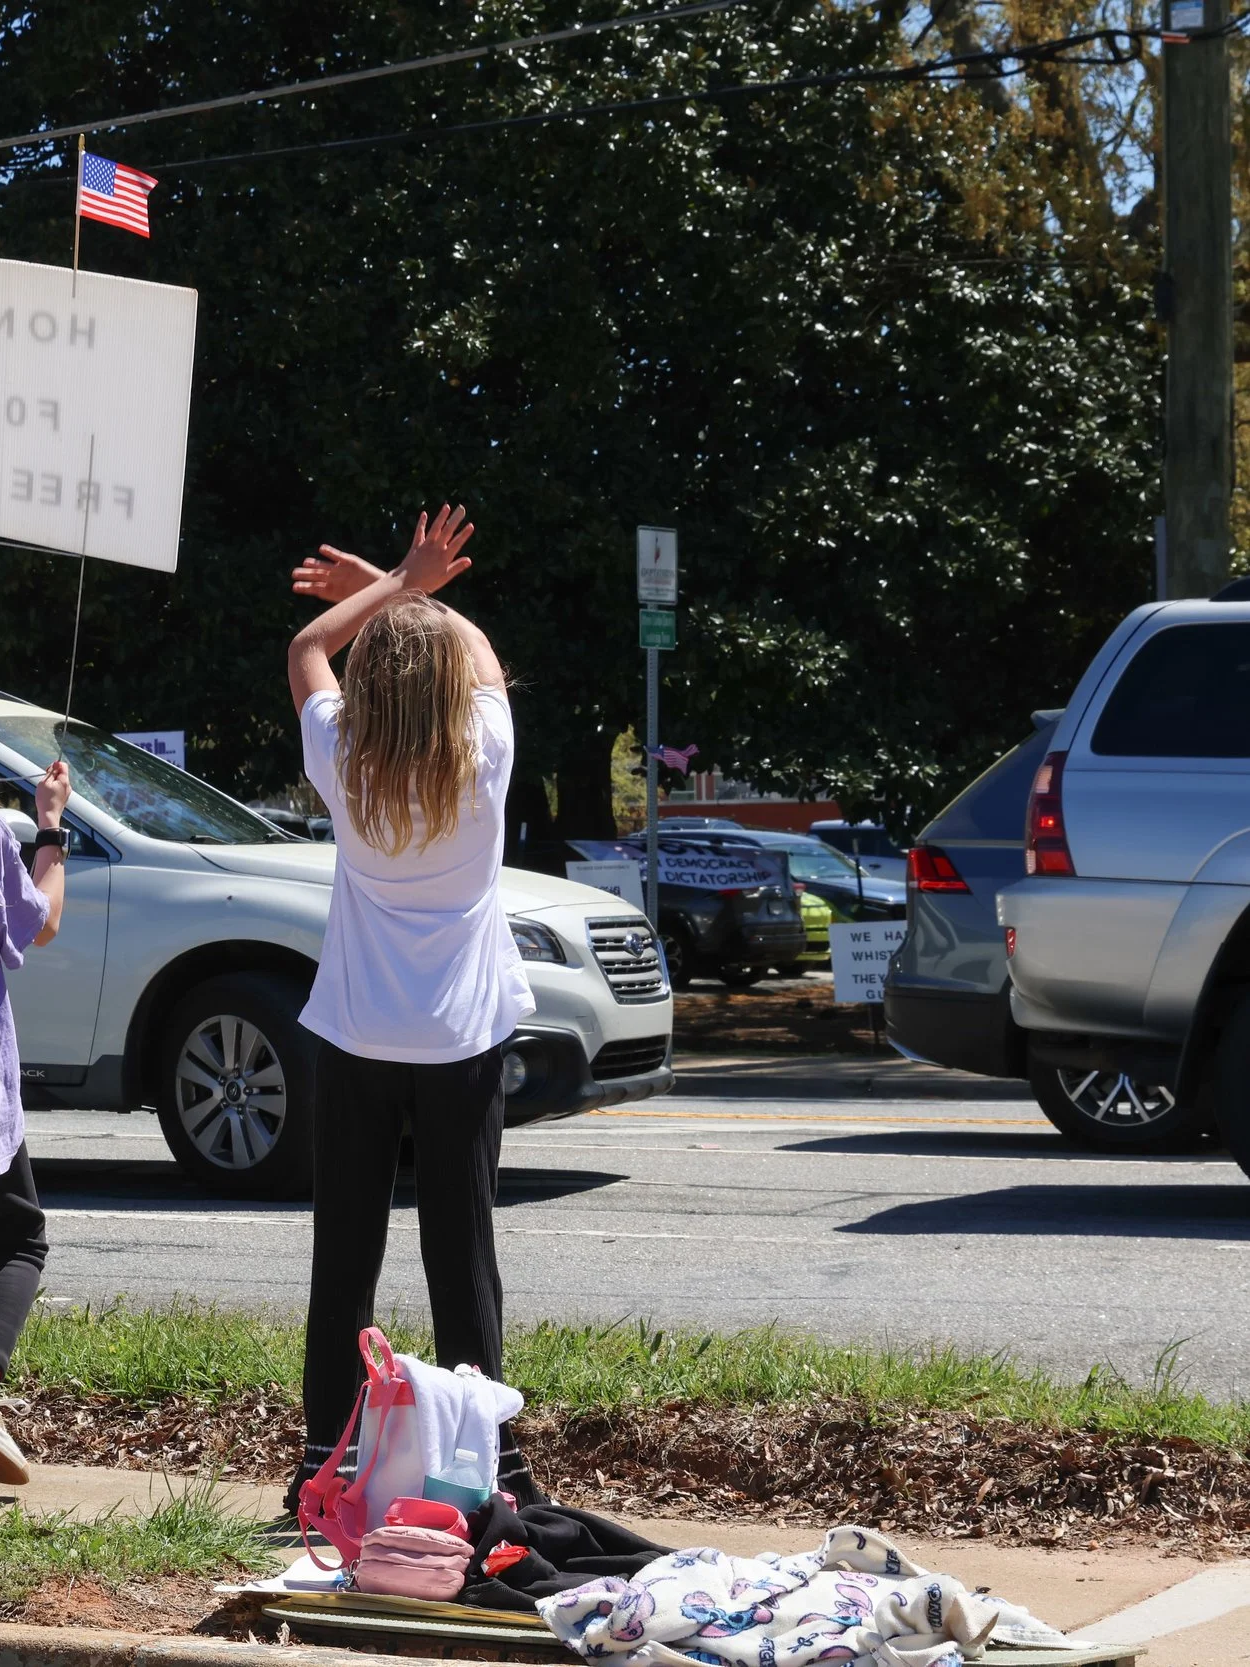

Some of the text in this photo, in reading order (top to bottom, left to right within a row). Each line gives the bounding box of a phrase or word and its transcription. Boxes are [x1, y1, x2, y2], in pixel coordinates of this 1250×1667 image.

[666, 857, 755, 870] DEMOCRACY
[665, 871, 772, 885] DICTATORSHIP
[850, 931, 872, 942] WE
[851, 950, 894, 961] WHIST
[851, 973, 885, 984] THEY
[866, 989, 884, 999] GU
[20, 1069, 46, 1078] ACK
